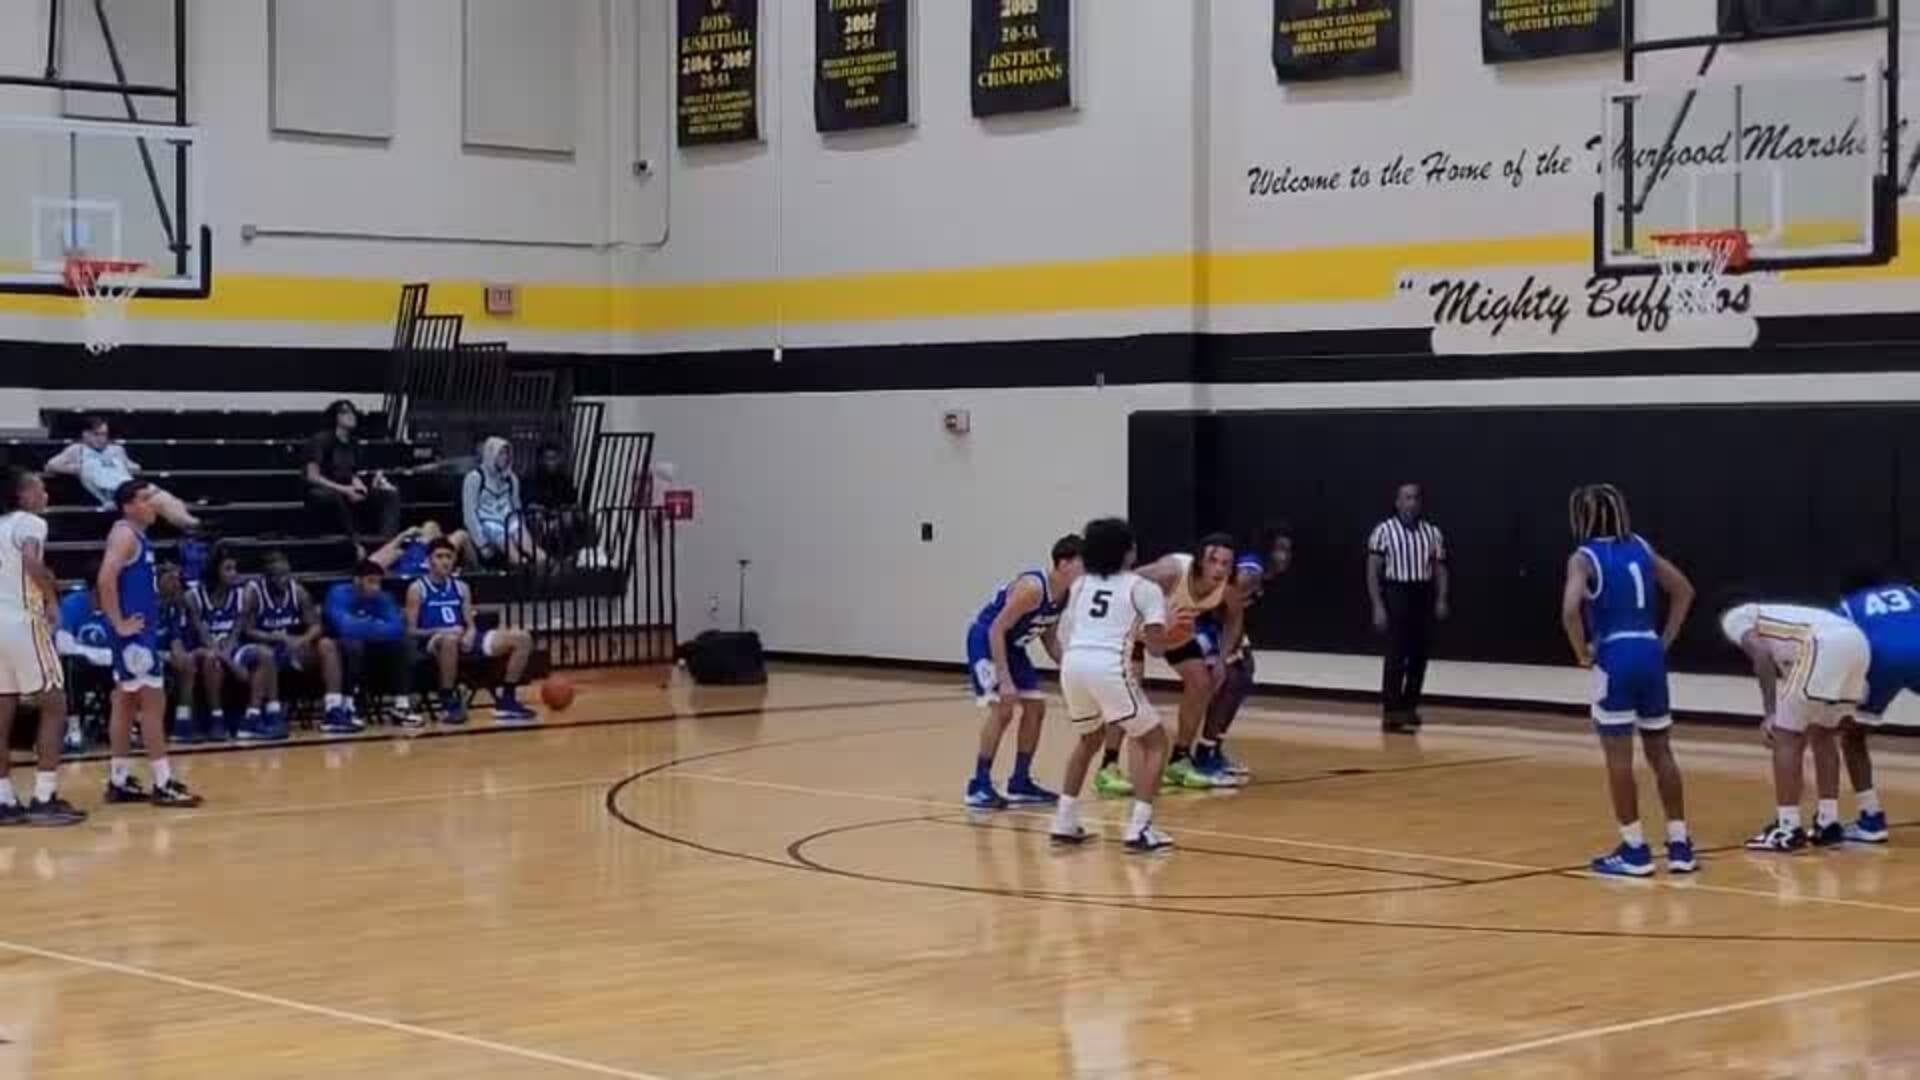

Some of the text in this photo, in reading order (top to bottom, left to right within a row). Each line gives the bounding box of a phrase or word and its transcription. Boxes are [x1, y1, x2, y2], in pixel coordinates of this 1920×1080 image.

[991, 48, 1052, 69] DISTRICT
[978, 64, 1063, 88] CHAMPIONS
[1247, 166, 1342, 196] Welcome
[1350, 166, 1371, 188] to
[1380, 155, 1415, 187] the
[1421, 151, 1493, 183] Home
[1503, 149, 1527, 188] of
[1536, 145, 1572, 176] the
[1429, 276, 1570, 336] Mighty
[1585, 274, 1751, 332] Buffos
[1628, 561, 1645, 609] 1
[441, 606, 456, 623] 0
[1089, 589, 1113, 618] 5
[1865, 589, 1911, 616] 43
